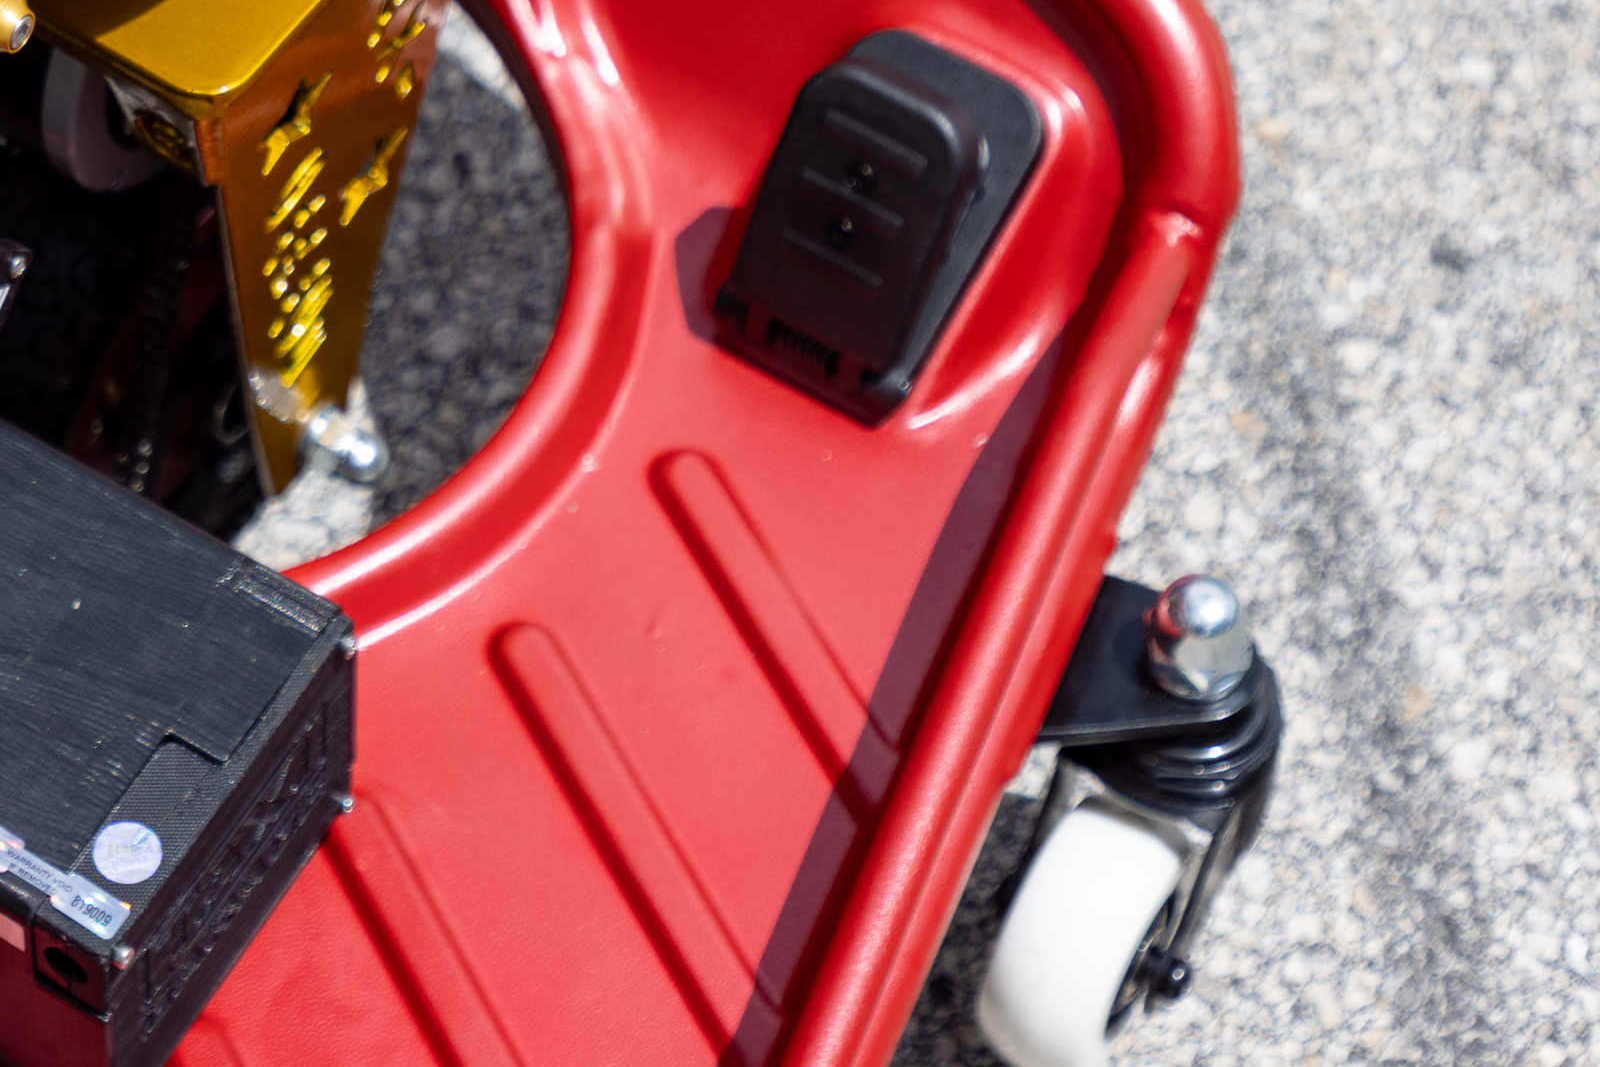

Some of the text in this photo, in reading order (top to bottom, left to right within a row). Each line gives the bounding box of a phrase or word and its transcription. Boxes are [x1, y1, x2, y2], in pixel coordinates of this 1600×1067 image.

[7, 849, 73, 893] WARRANTY VOID
[9, 863, 58, 895] IF REMOVED
[71, 895, 113, 927] 819009
